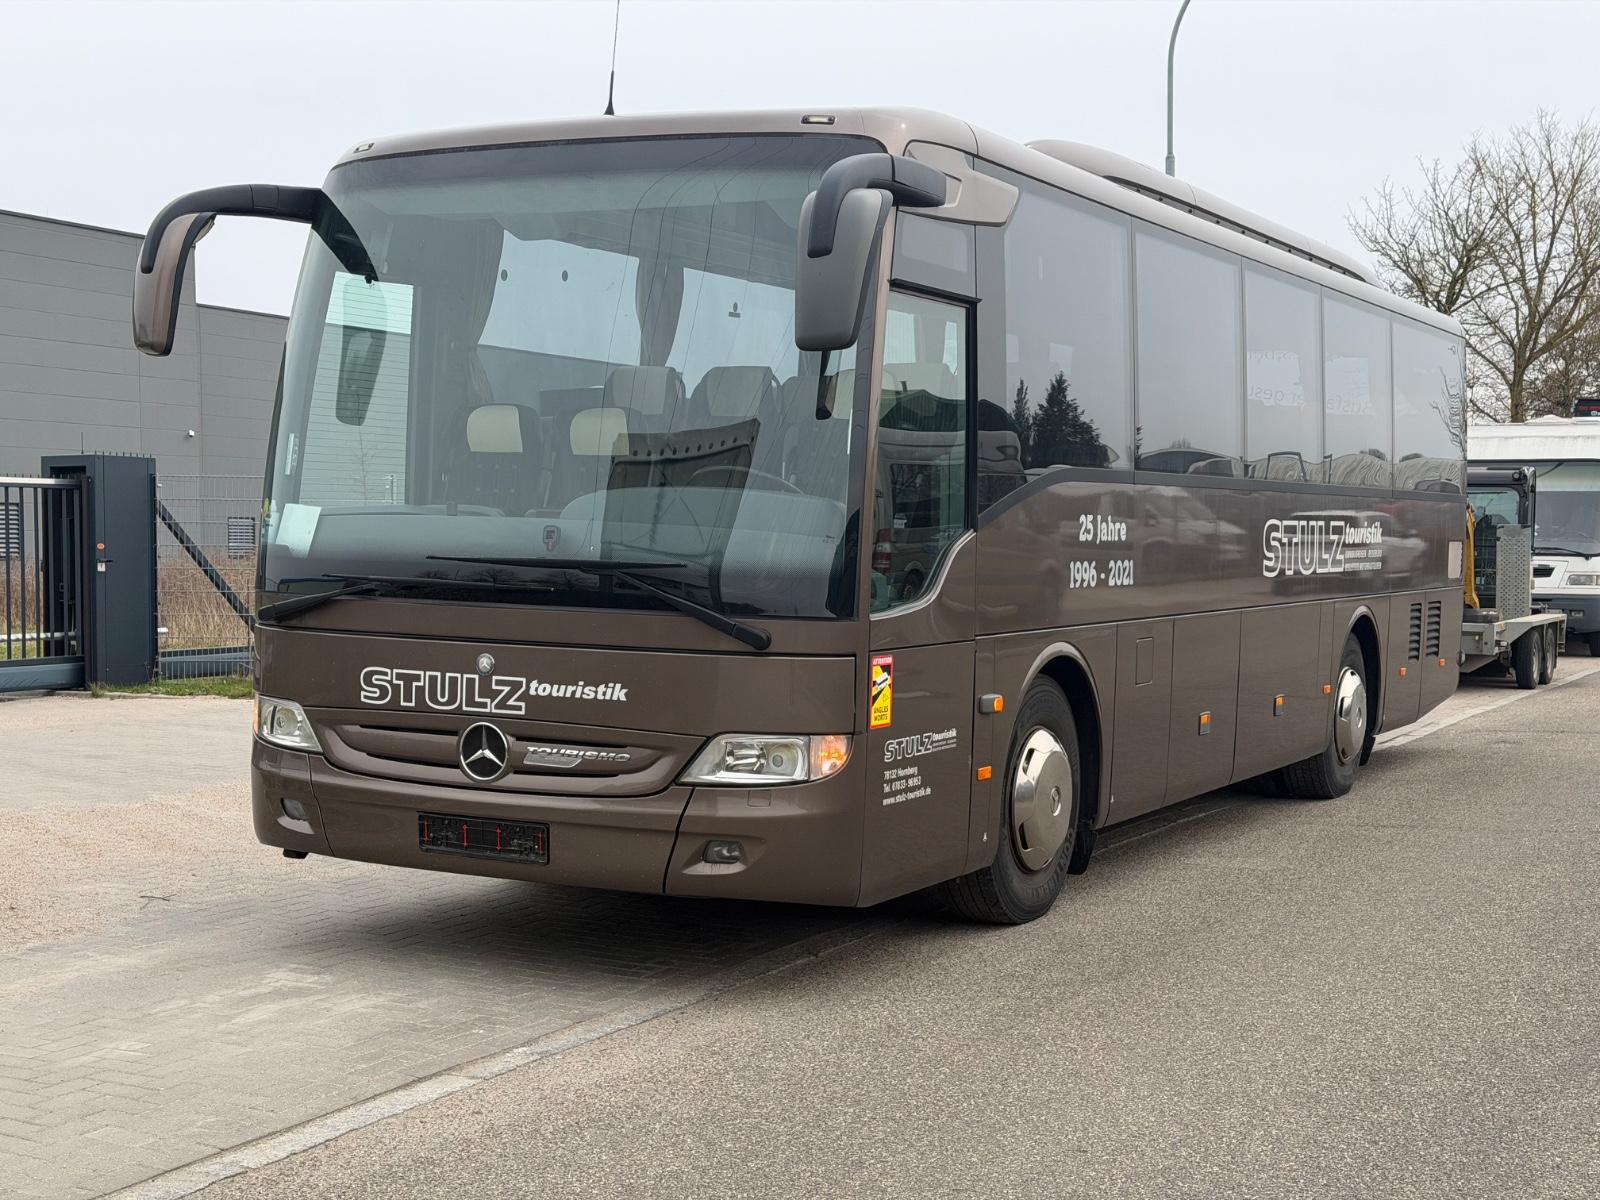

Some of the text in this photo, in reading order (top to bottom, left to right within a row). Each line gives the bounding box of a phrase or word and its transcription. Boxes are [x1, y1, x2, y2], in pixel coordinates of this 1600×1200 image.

[1079, 514, 1127, 544] 25 Jahre
[1263, 519, 1383, 578] STULZ touristik
[1070, 561, 1097, 588] 1996
[1108, 560, 1134, 586] 2021
[360, 666, 629, 715] STULZ touristik
[527, 746, 631, 762] TOURISMO
[884, 728, 957, 762] STULZ touristik
[897, 765, 918, 777] Hornberg
